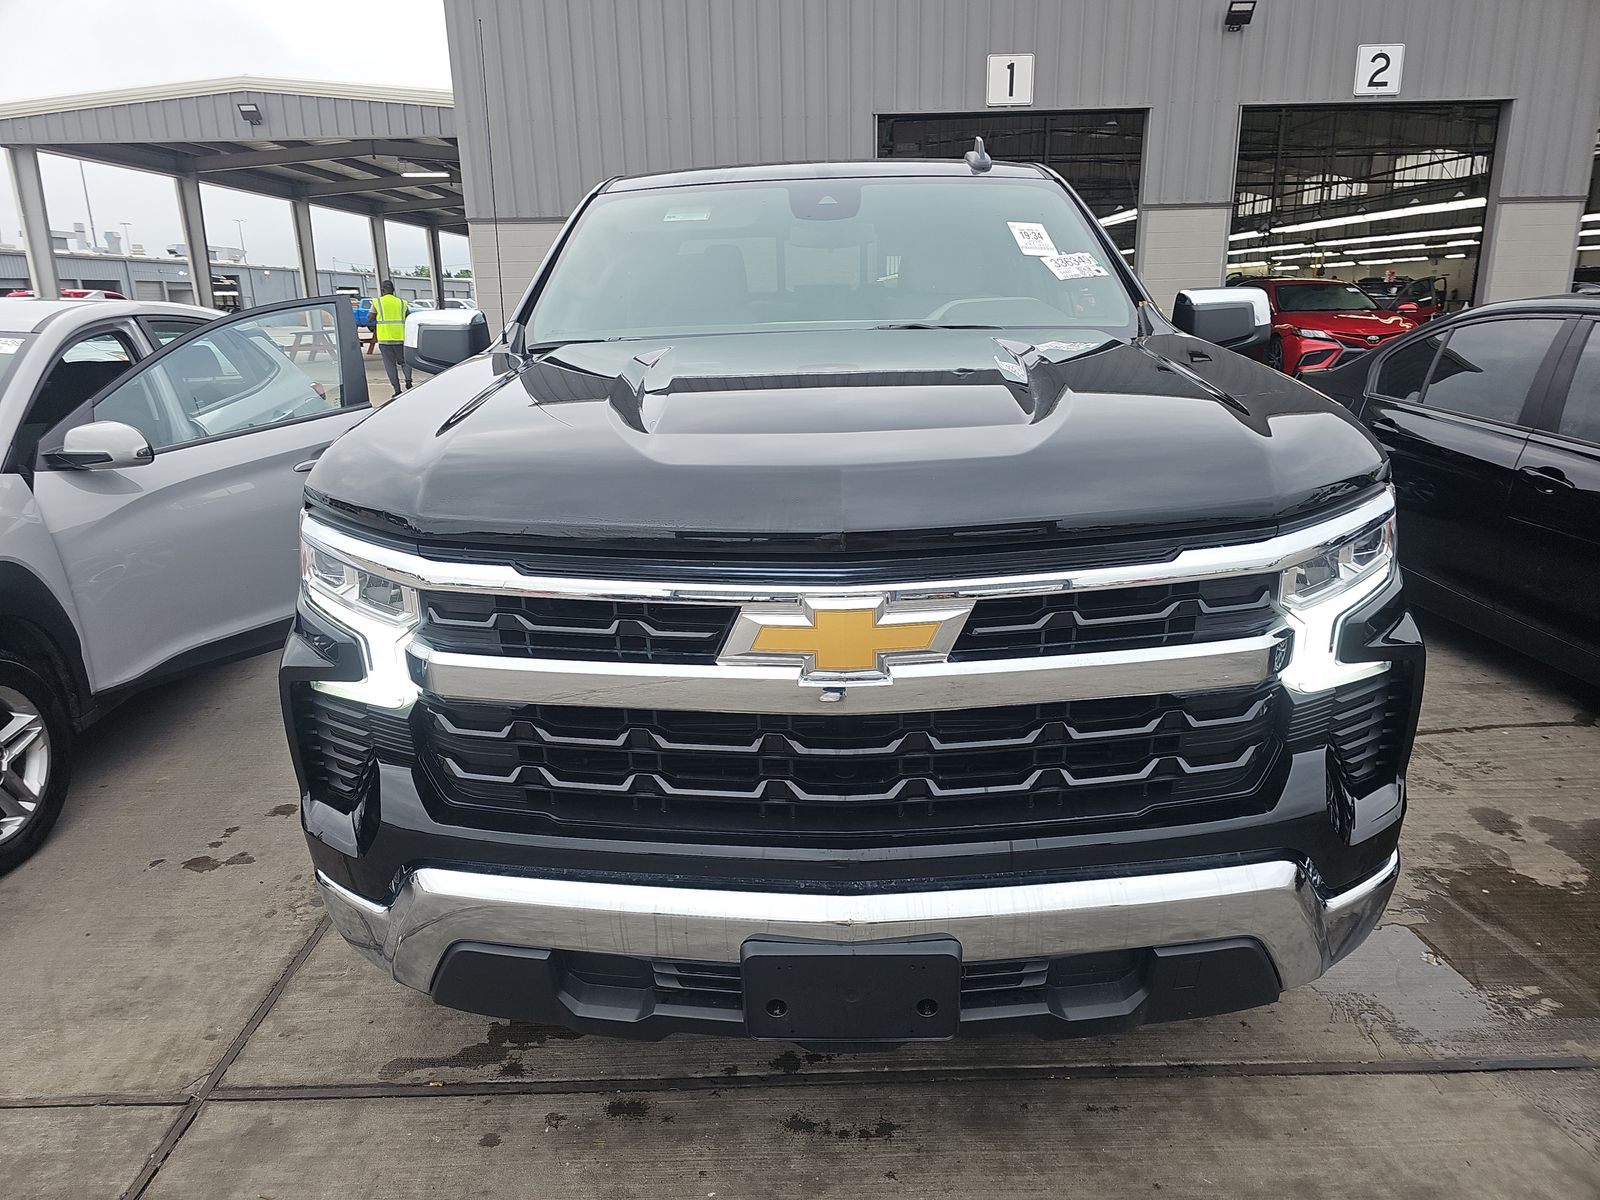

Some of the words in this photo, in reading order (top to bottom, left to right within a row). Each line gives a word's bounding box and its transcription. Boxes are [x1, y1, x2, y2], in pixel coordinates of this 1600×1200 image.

[1007, 62, 1015, 97] 1
[1367, 52, 1391, 87] 2
[1019, 231, 1044, 241] 19:34
